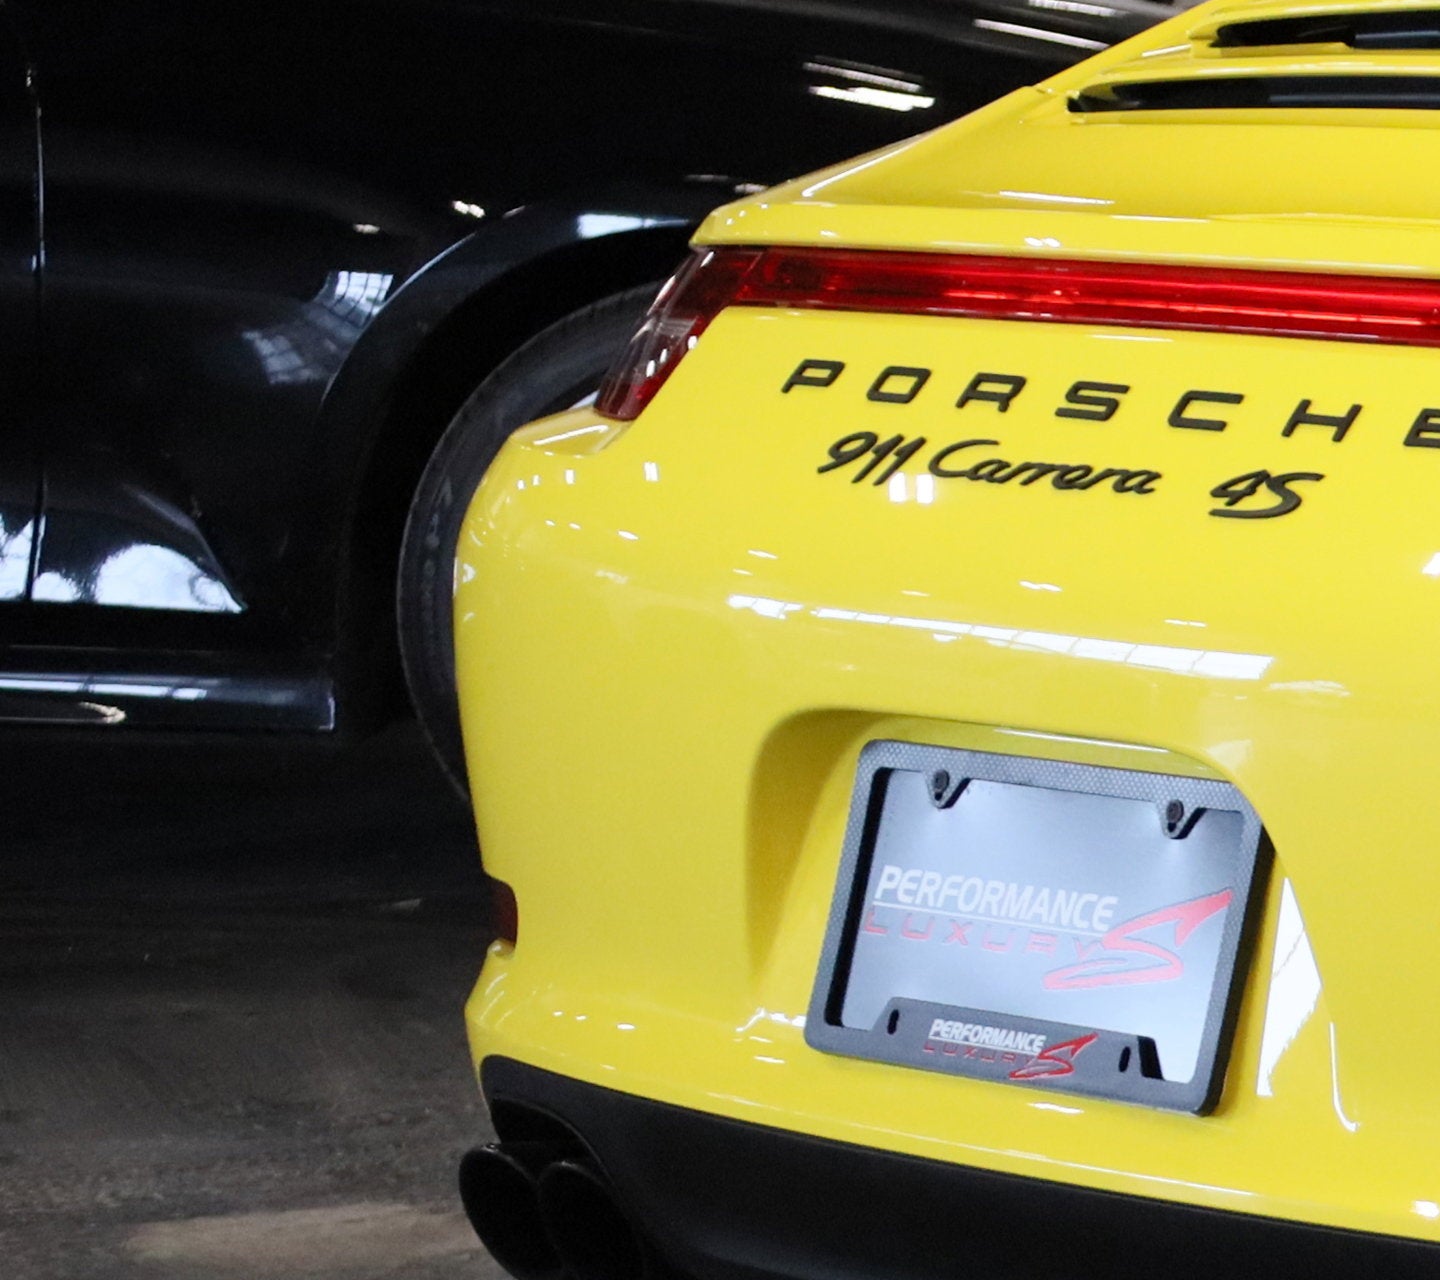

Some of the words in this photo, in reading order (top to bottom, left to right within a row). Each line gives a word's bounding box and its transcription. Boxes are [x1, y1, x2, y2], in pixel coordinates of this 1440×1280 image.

[816, 431, 927, 486] 911
[927, 439, 1163, 494] Carrera
[1208, 469, 1326, 519] 4S
[873, 864, 1120, 933] PERFORMANCE
[863, 909, 1100, 961] LUXURY
[928, 1018, 1048, 1054] PERFORMANCE
